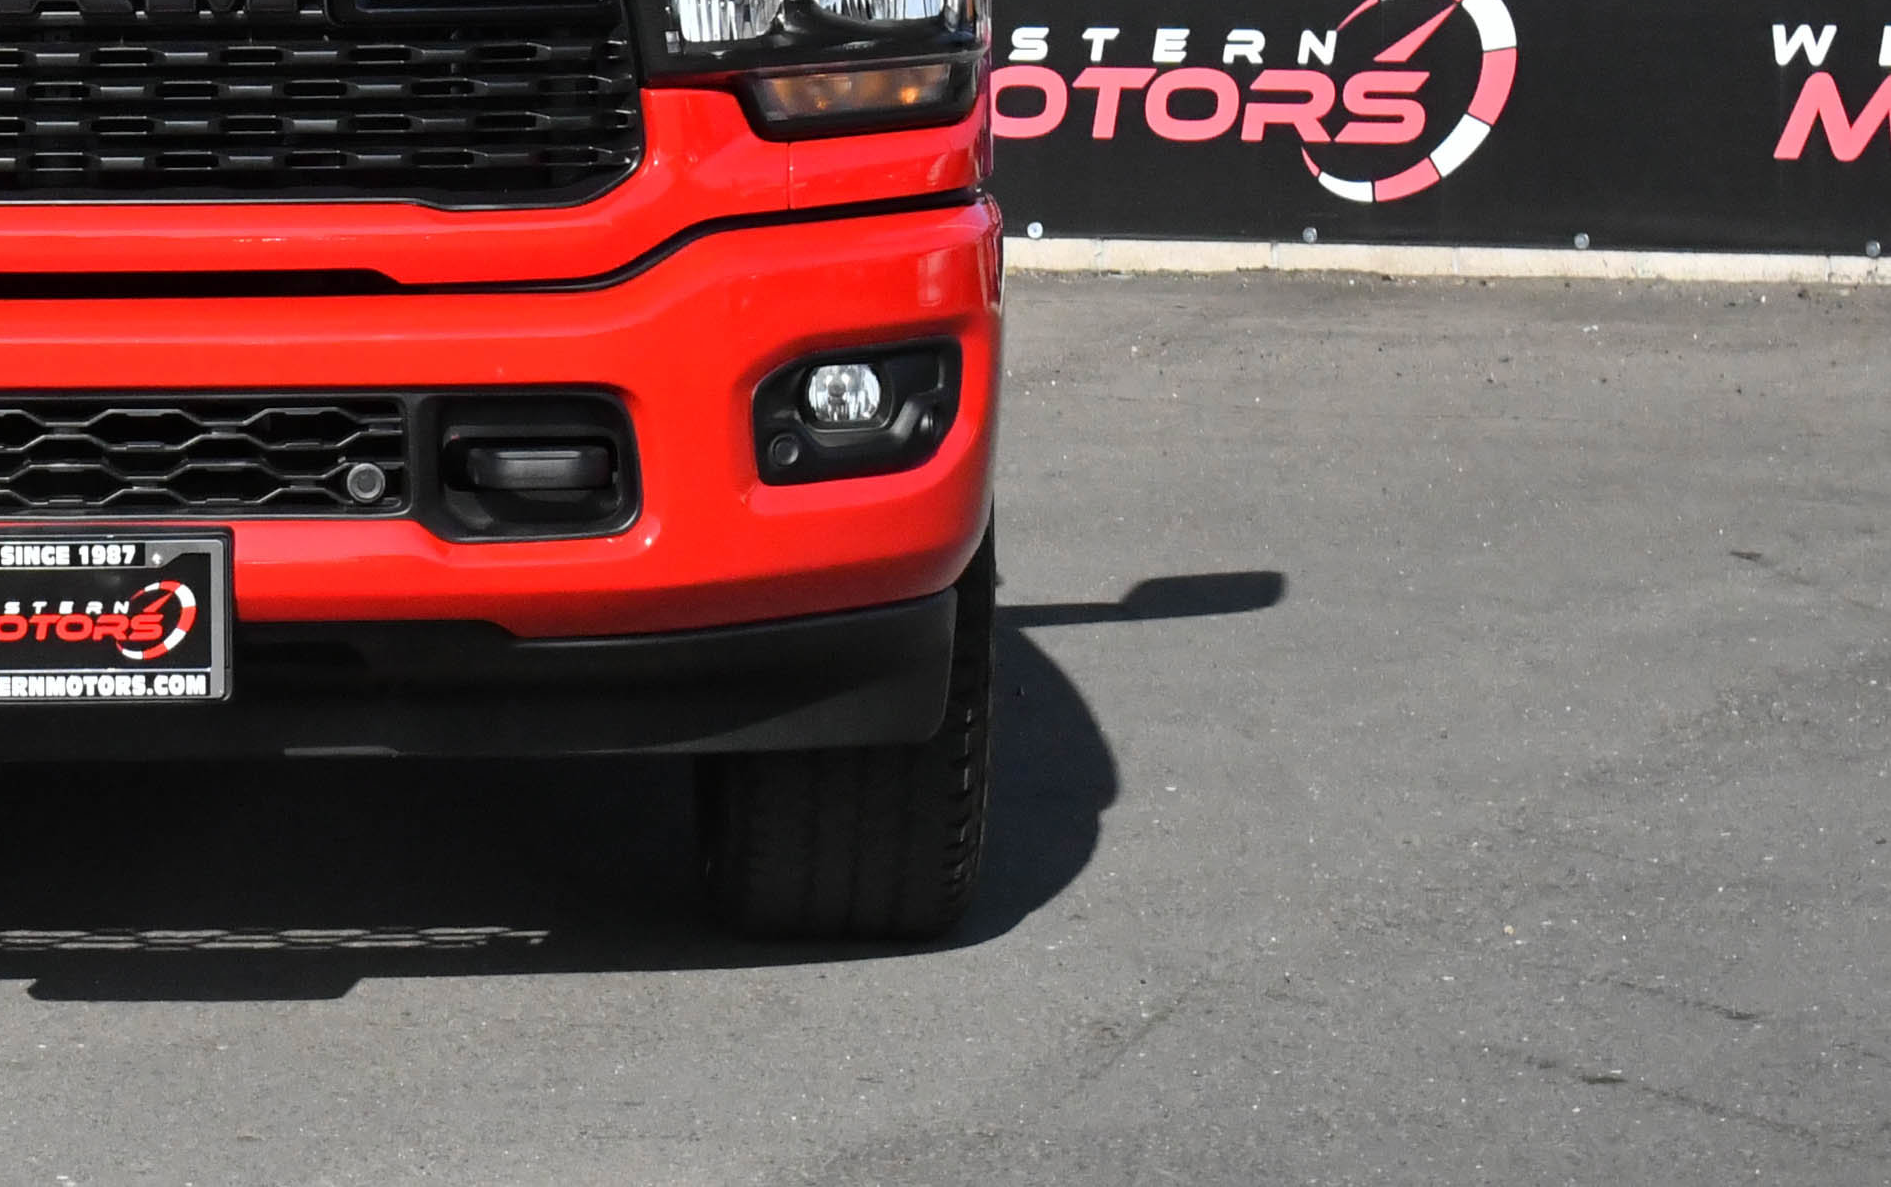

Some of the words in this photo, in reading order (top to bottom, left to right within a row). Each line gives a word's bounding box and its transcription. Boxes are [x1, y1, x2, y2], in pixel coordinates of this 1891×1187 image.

[1008, 26, 1338, 66] STERN
[990, 65, 1431, 145] OTORS
[0, 545, 70, 566] SINCE
[78, 544, 136, 566] 1987
